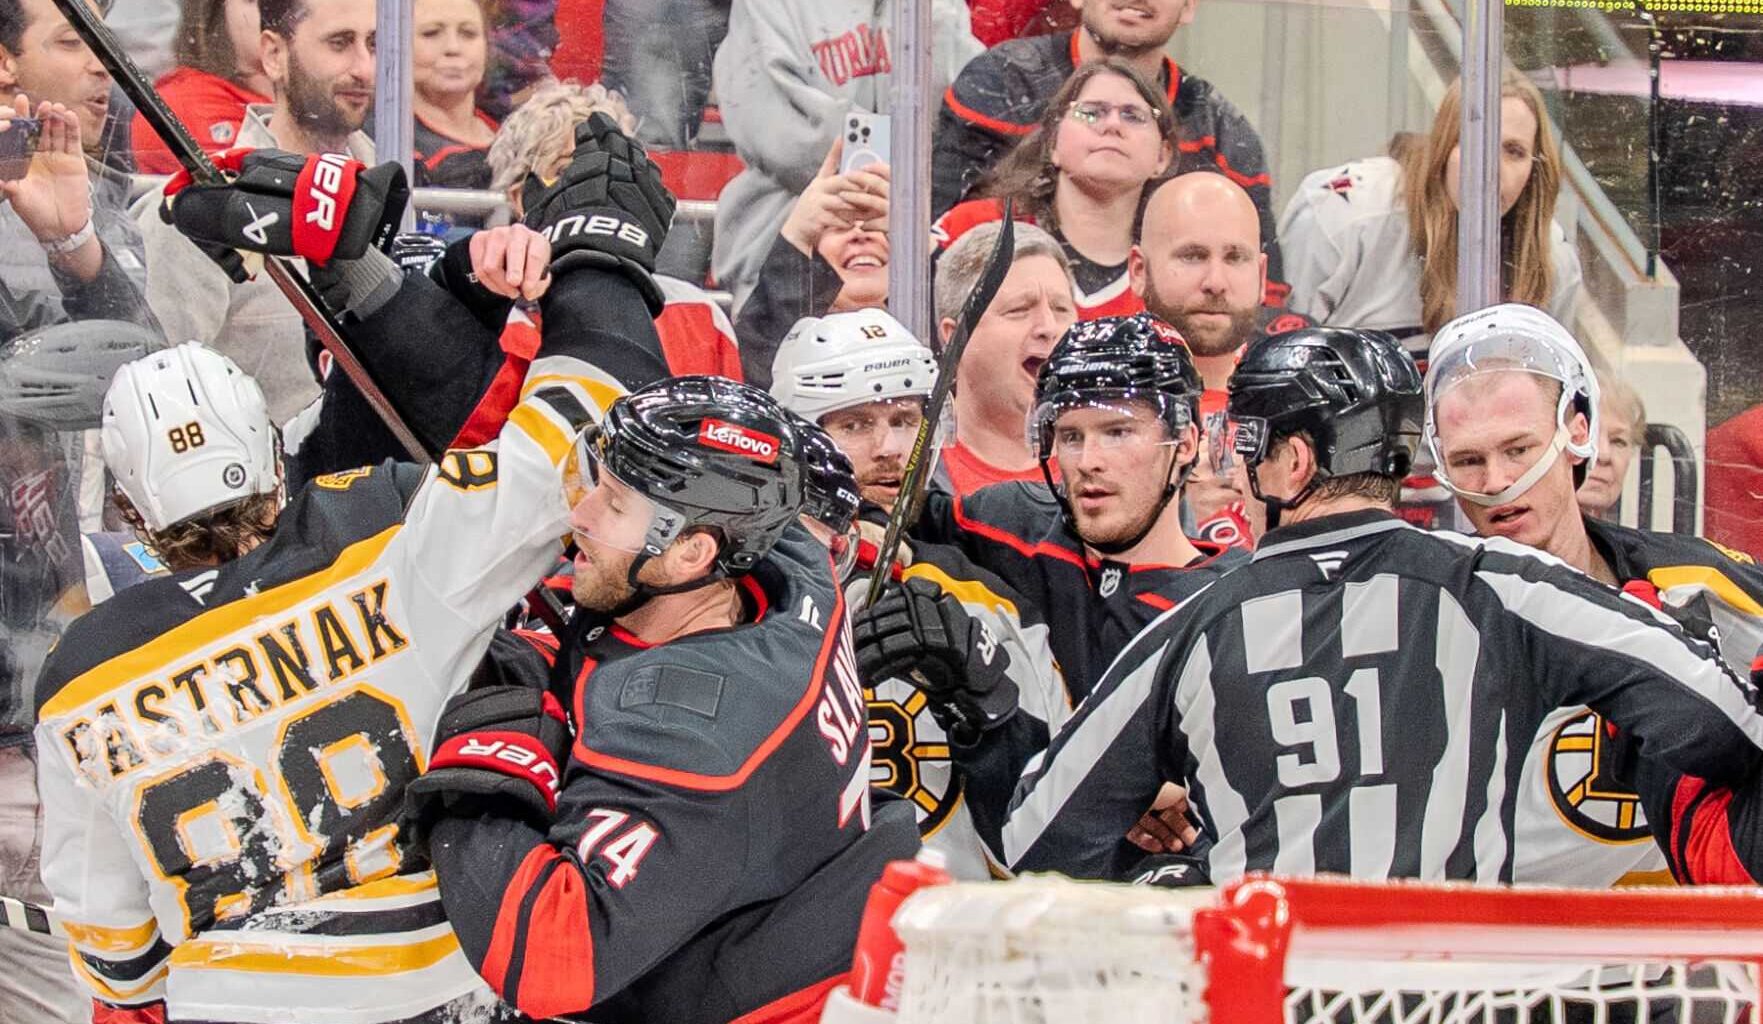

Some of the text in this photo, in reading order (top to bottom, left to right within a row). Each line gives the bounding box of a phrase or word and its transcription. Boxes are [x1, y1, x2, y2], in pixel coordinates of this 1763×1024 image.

[860, 325, 888, 339] 12
[1077, 323, 1116, 342] 37
[168, 421, 205, 454] 88
[706, 424, 772, 456] Lenovo
[1266, 667, 1384, 788] 91
[576, 807, 661, 890] 74
